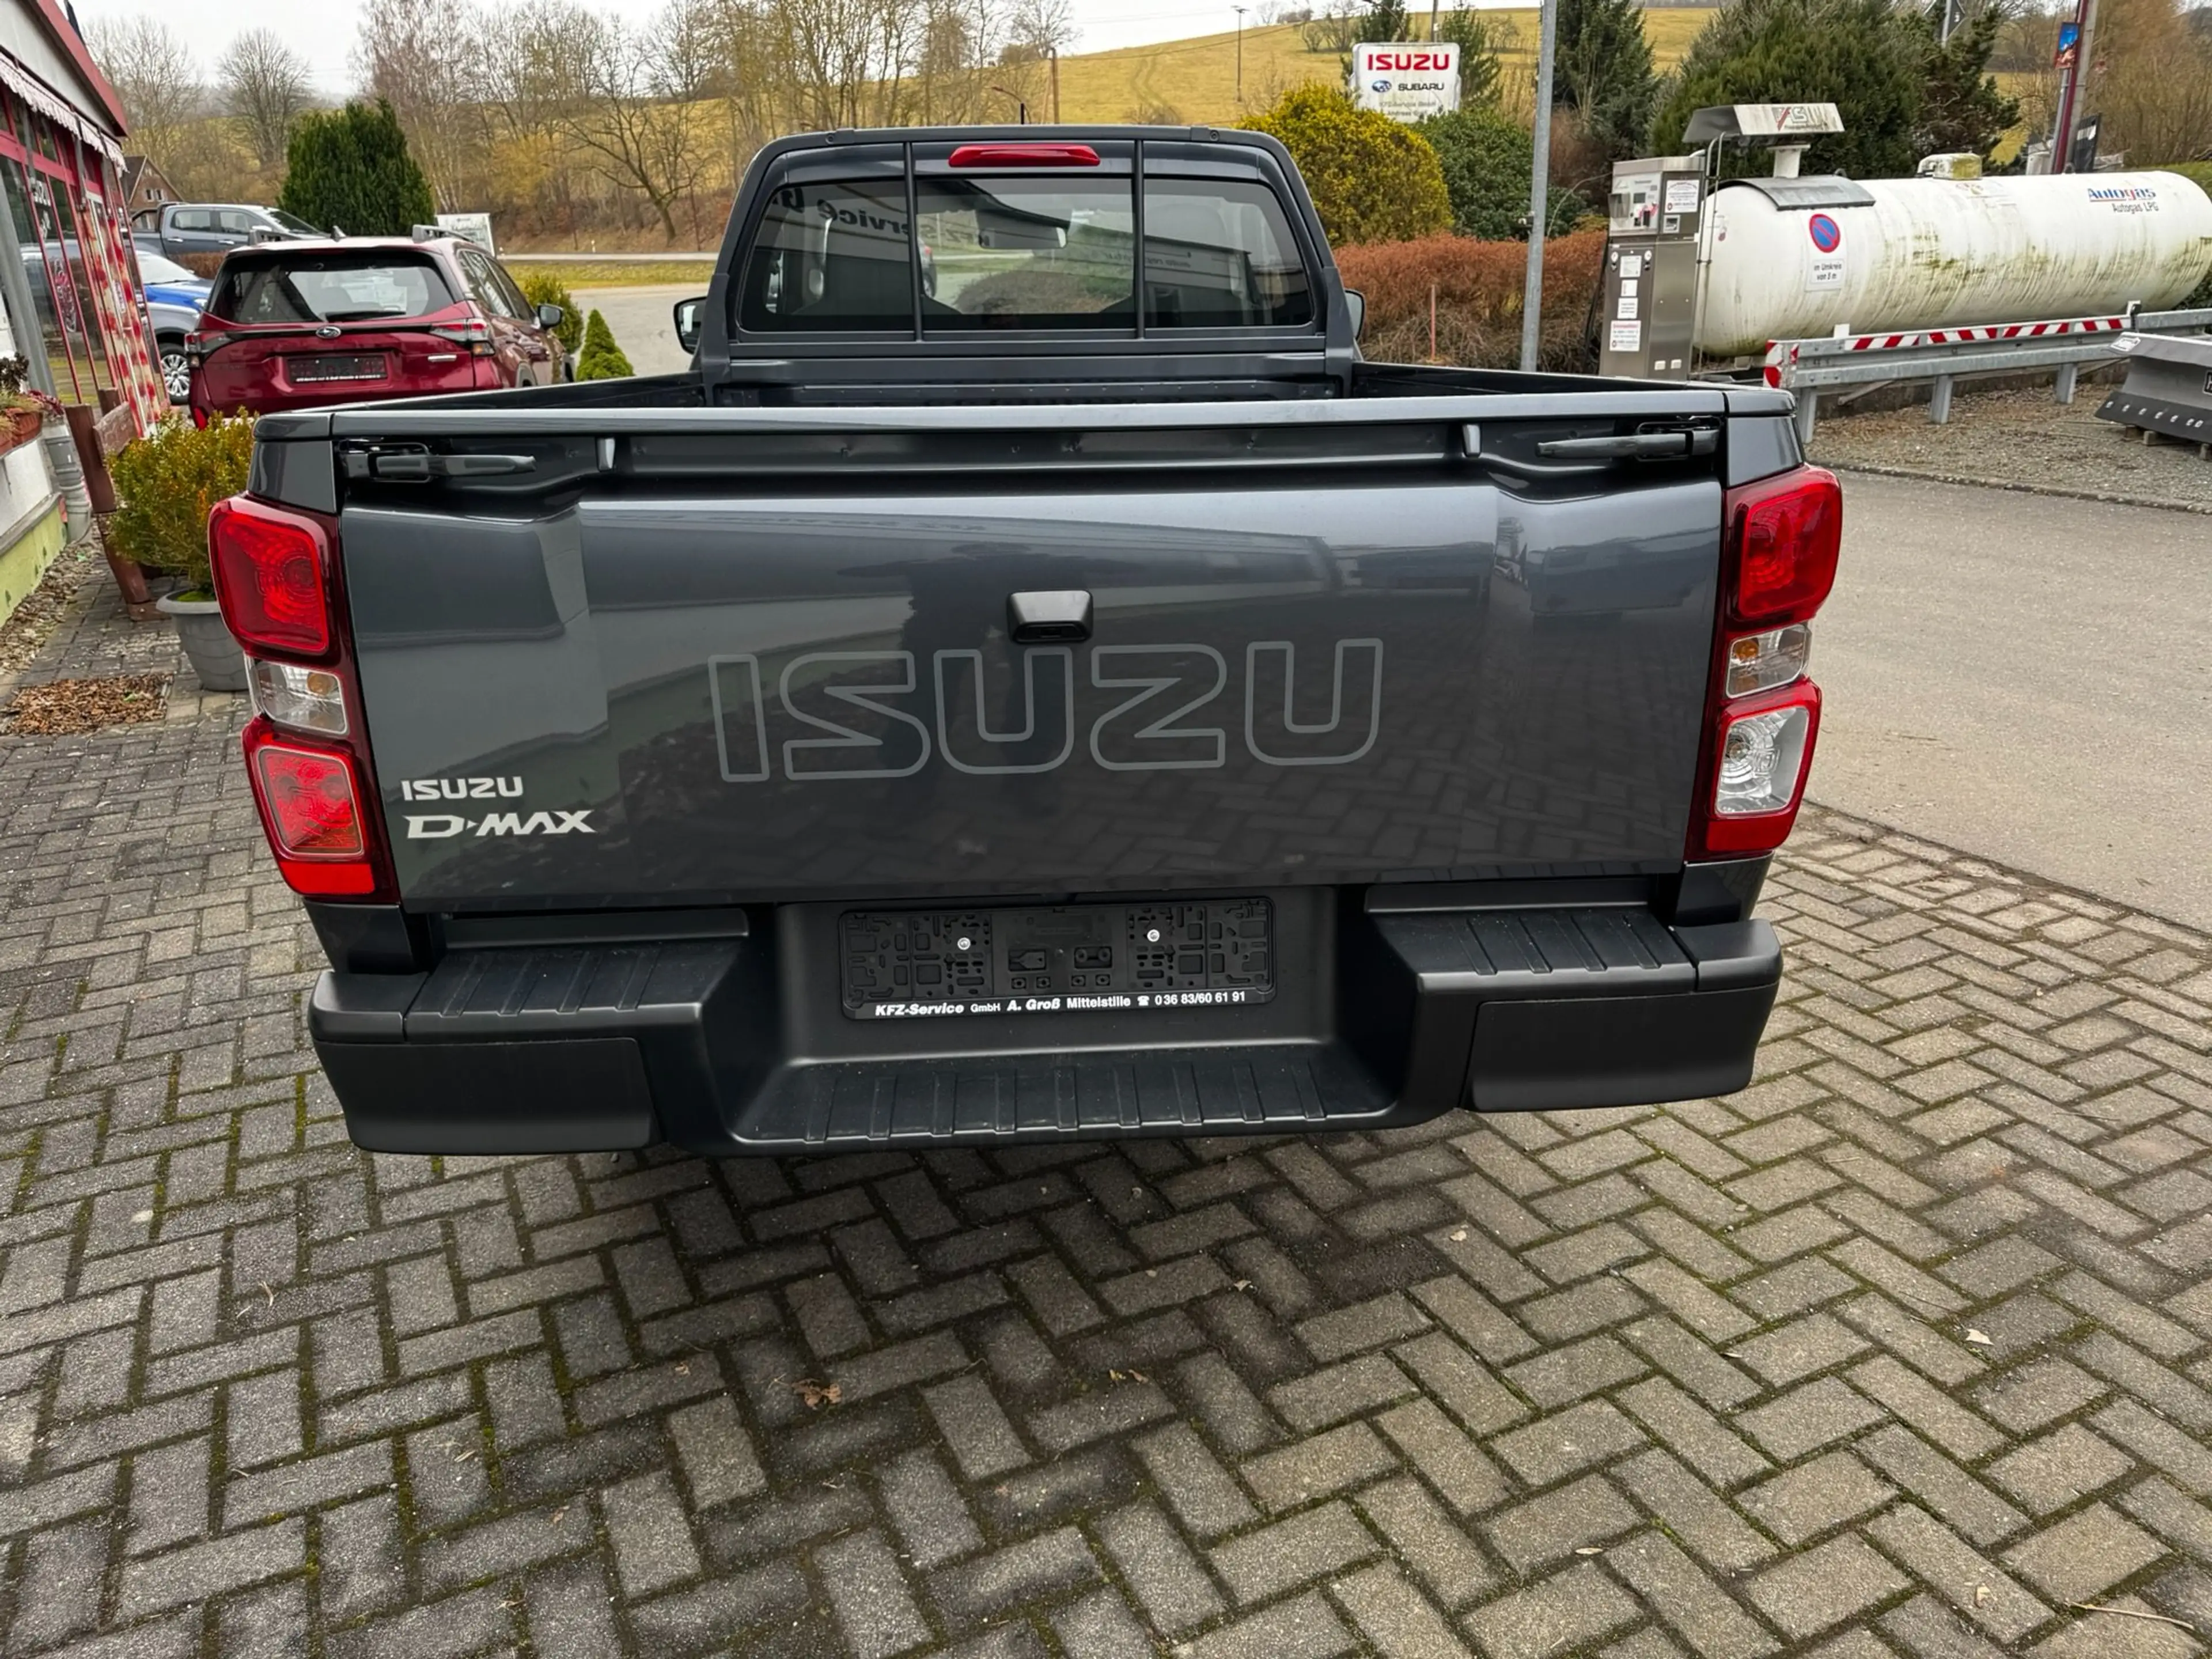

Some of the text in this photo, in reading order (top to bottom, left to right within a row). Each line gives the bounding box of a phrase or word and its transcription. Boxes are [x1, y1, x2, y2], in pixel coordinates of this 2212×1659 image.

[1368, 54, 1449, 70] ISUZU
[1398, 82, 1444, 91] SUBARU
[2088, 188, 2157, 200] Autogas
[708, 638, 1384, 782] ISUZU
[401, 776, 524, 801] ISUZU
[875, 1002, 964, 1016] KFZ-Service
[970, 1003, 1001, 1013] GmbH
[1007, 1000, 1021, 1011] A.
[1026, 998, 1060, 1010] Groß
[1067, 996, 1131, 1009] Mittelstille
[1181, 993, 1212, 1005] 83/60
[1215, 992, 1229, 1003] 61
[1232, 991, 1245, 1002] 91
